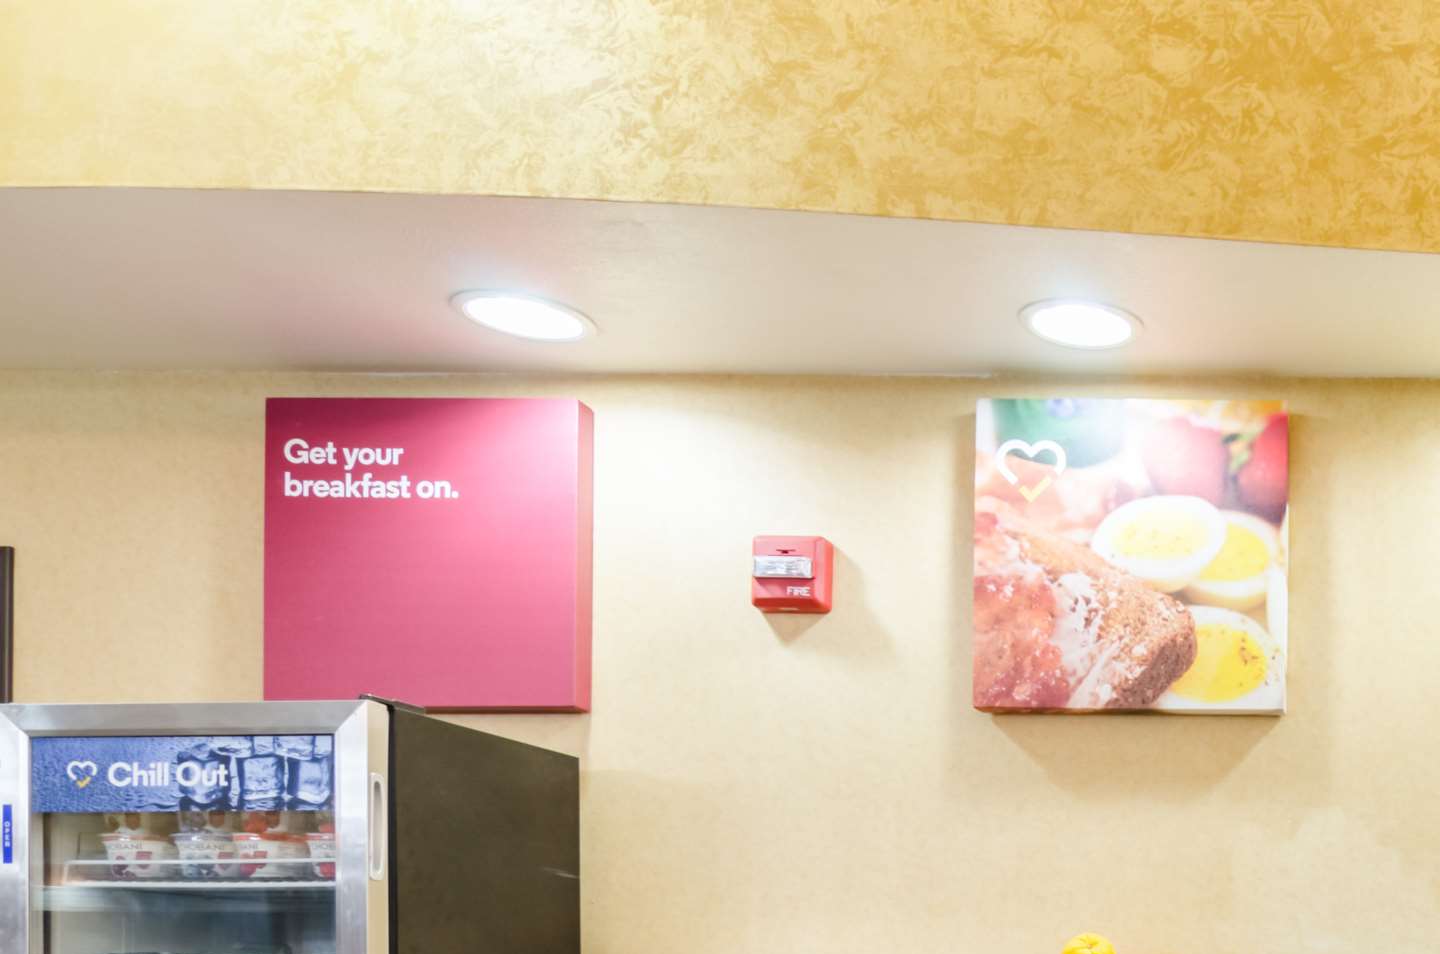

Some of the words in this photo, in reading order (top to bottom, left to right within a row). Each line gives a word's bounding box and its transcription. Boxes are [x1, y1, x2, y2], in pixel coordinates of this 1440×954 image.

[284, 438, 337, 464] Get
[343, 447, 404, 470] your
[284, 472, 411, 498] breakfast
[416, 480, 459, 499] on.
[786, 586, 811, 597] FIRE
[108, 761, 169, 787] Chill
[175, 760, 229, 787] Out
